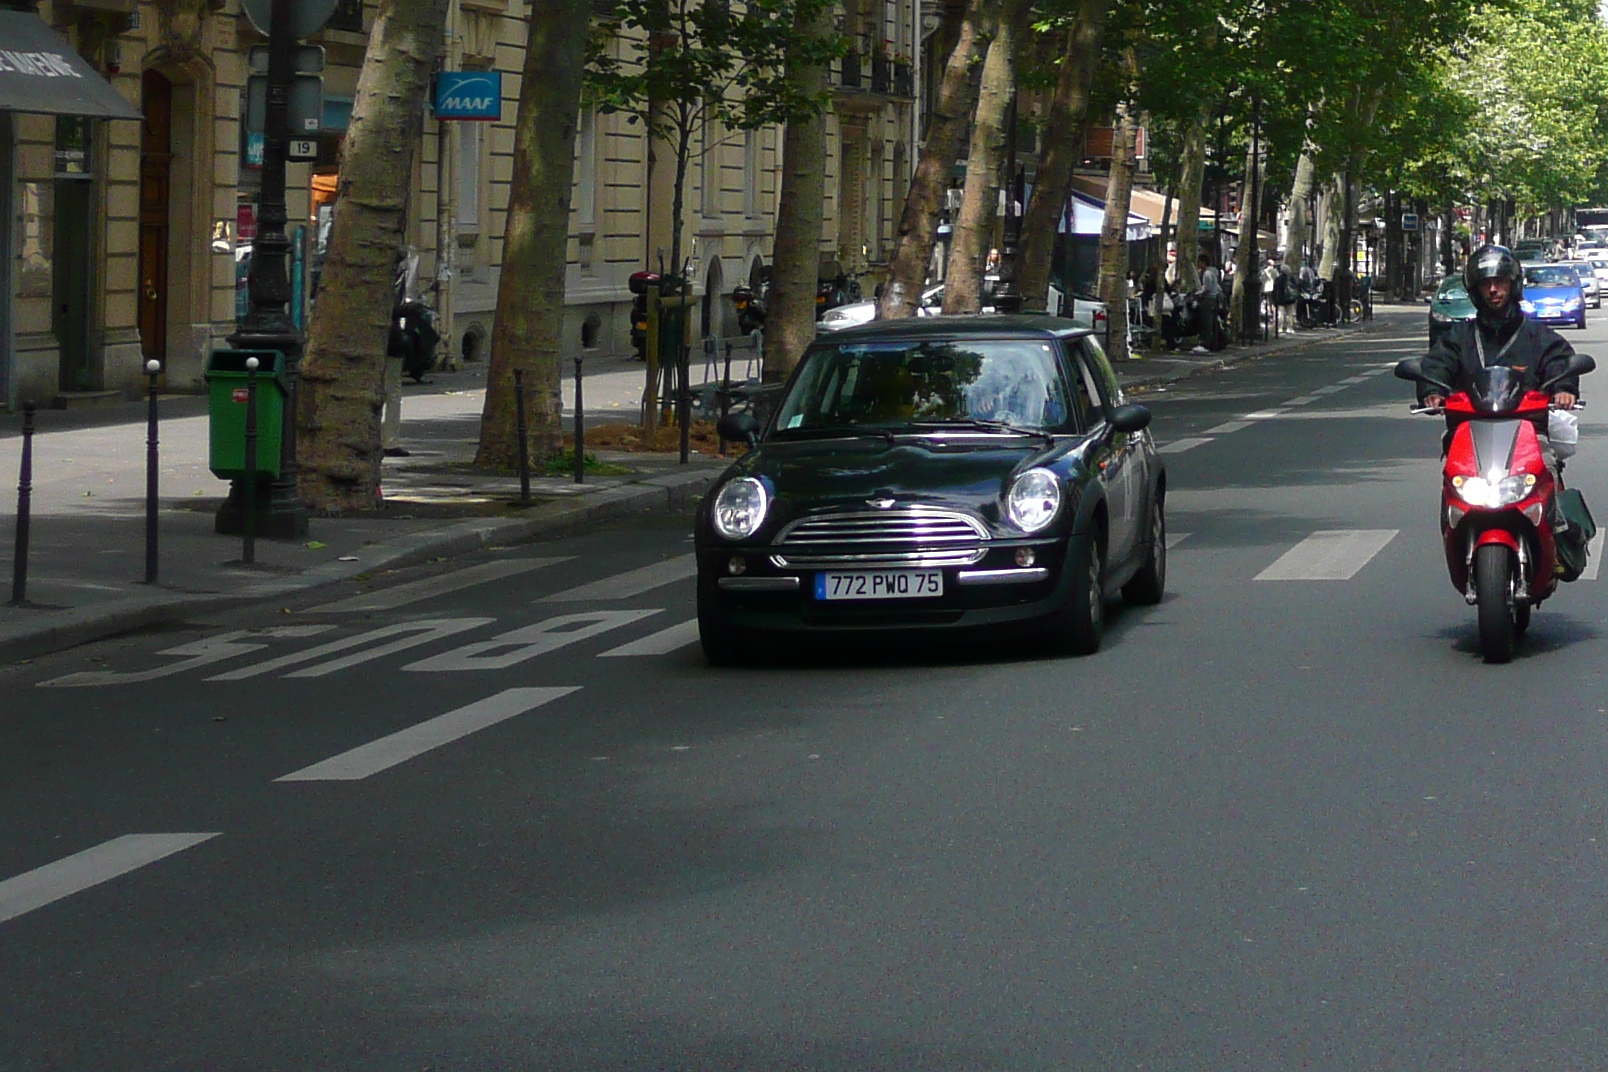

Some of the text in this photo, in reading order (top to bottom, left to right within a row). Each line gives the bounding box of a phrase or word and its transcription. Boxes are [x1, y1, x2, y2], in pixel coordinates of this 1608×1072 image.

[440, 96, 494, 110] MAAF
[297, 142, 310, 154] 19
[831, 573, 939, 595] 772 PWQ 75
[34, 609, 668, 688] BUS
